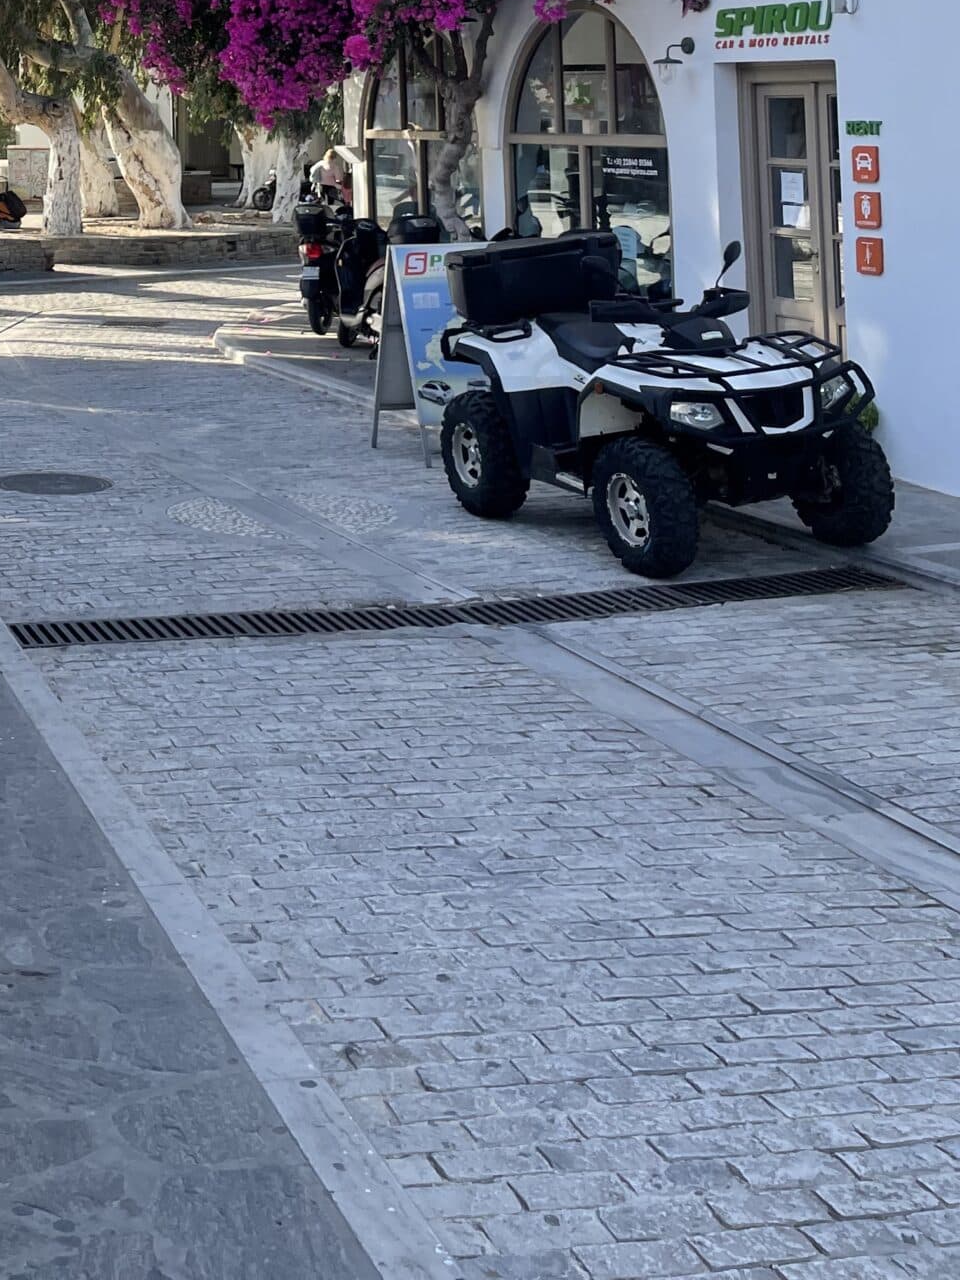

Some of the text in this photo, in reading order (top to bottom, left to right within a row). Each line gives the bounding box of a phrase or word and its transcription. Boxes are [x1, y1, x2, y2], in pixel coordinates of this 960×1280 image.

[714, 0, 833, 38] SPIROU
[715, 34, 830, 50] CAR & MOTO RENTALS
[845, 120, 883, 136] RENT
